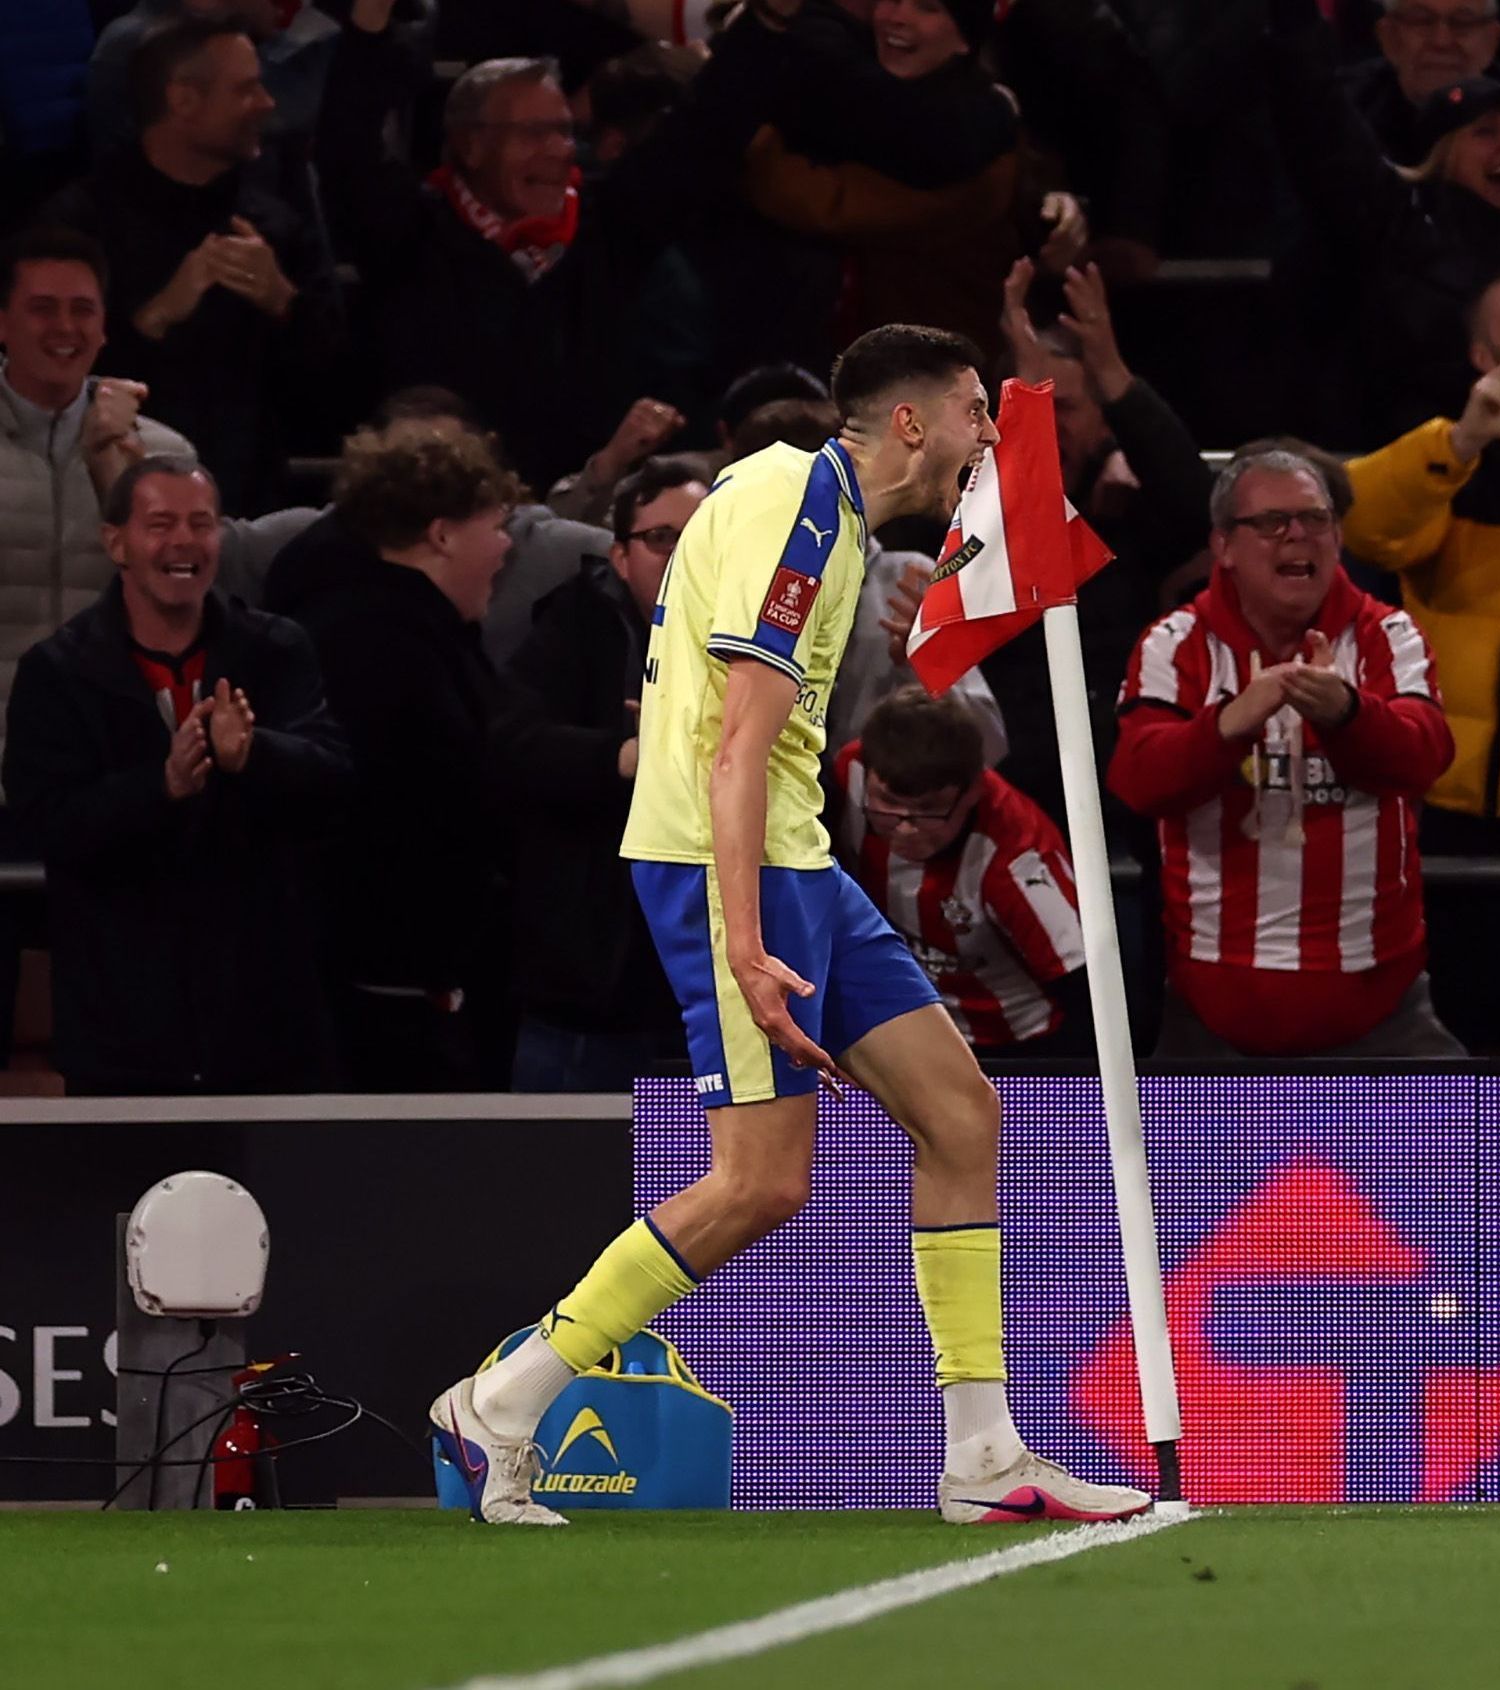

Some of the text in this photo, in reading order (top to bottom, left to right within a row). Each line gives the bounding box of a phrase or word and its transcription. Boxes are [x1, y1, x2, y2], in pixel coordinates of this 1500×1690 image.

[766, 608, 799, 627] FA CUP
[532, 1470, 638, 1494] Lucozade
